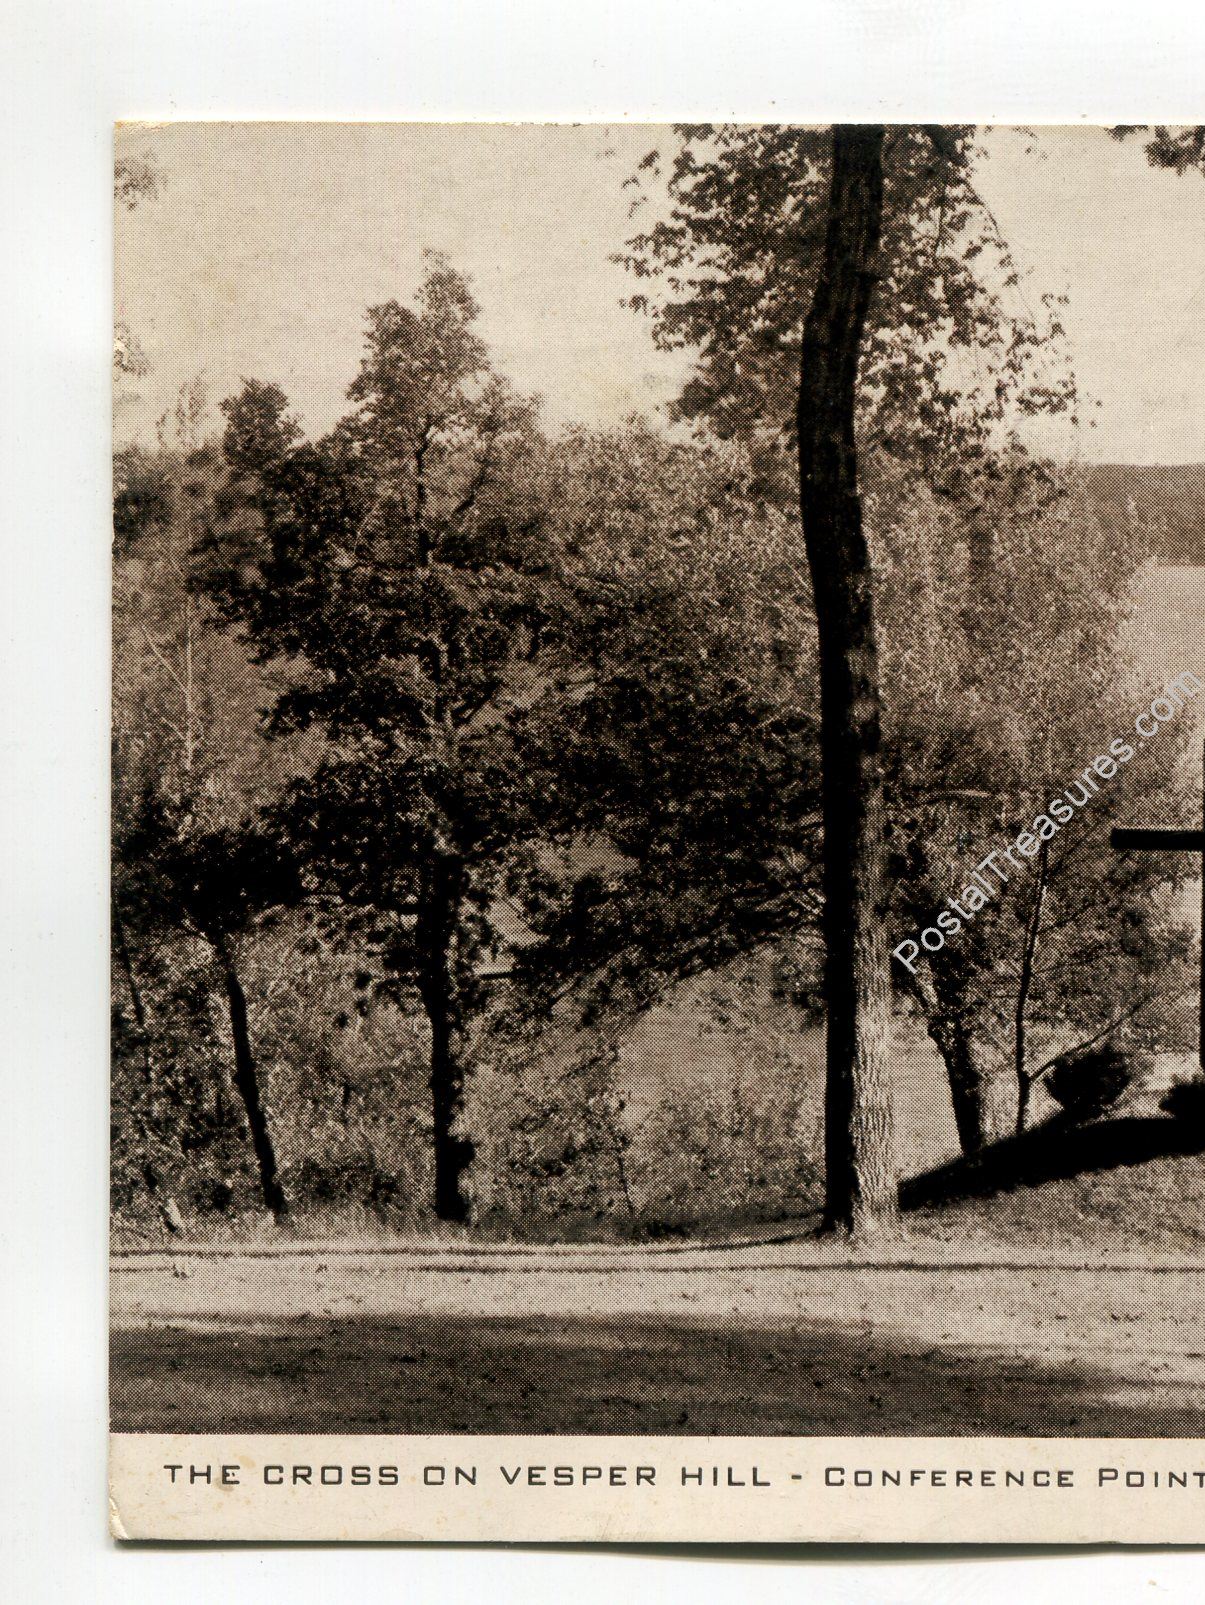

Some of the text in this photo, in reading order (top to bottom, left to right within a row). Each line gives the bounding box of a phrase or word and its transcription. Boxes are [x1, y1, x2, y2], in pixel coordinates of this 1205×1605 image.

[163, 1465, 240, 1484] THE
[263, 1465, 398, 1485] CROSS
[423, 1466, 476, 1485] ON
[500, 1466, 655, 1486] VESPER
[681, 1466, 770, 1486] HILL
